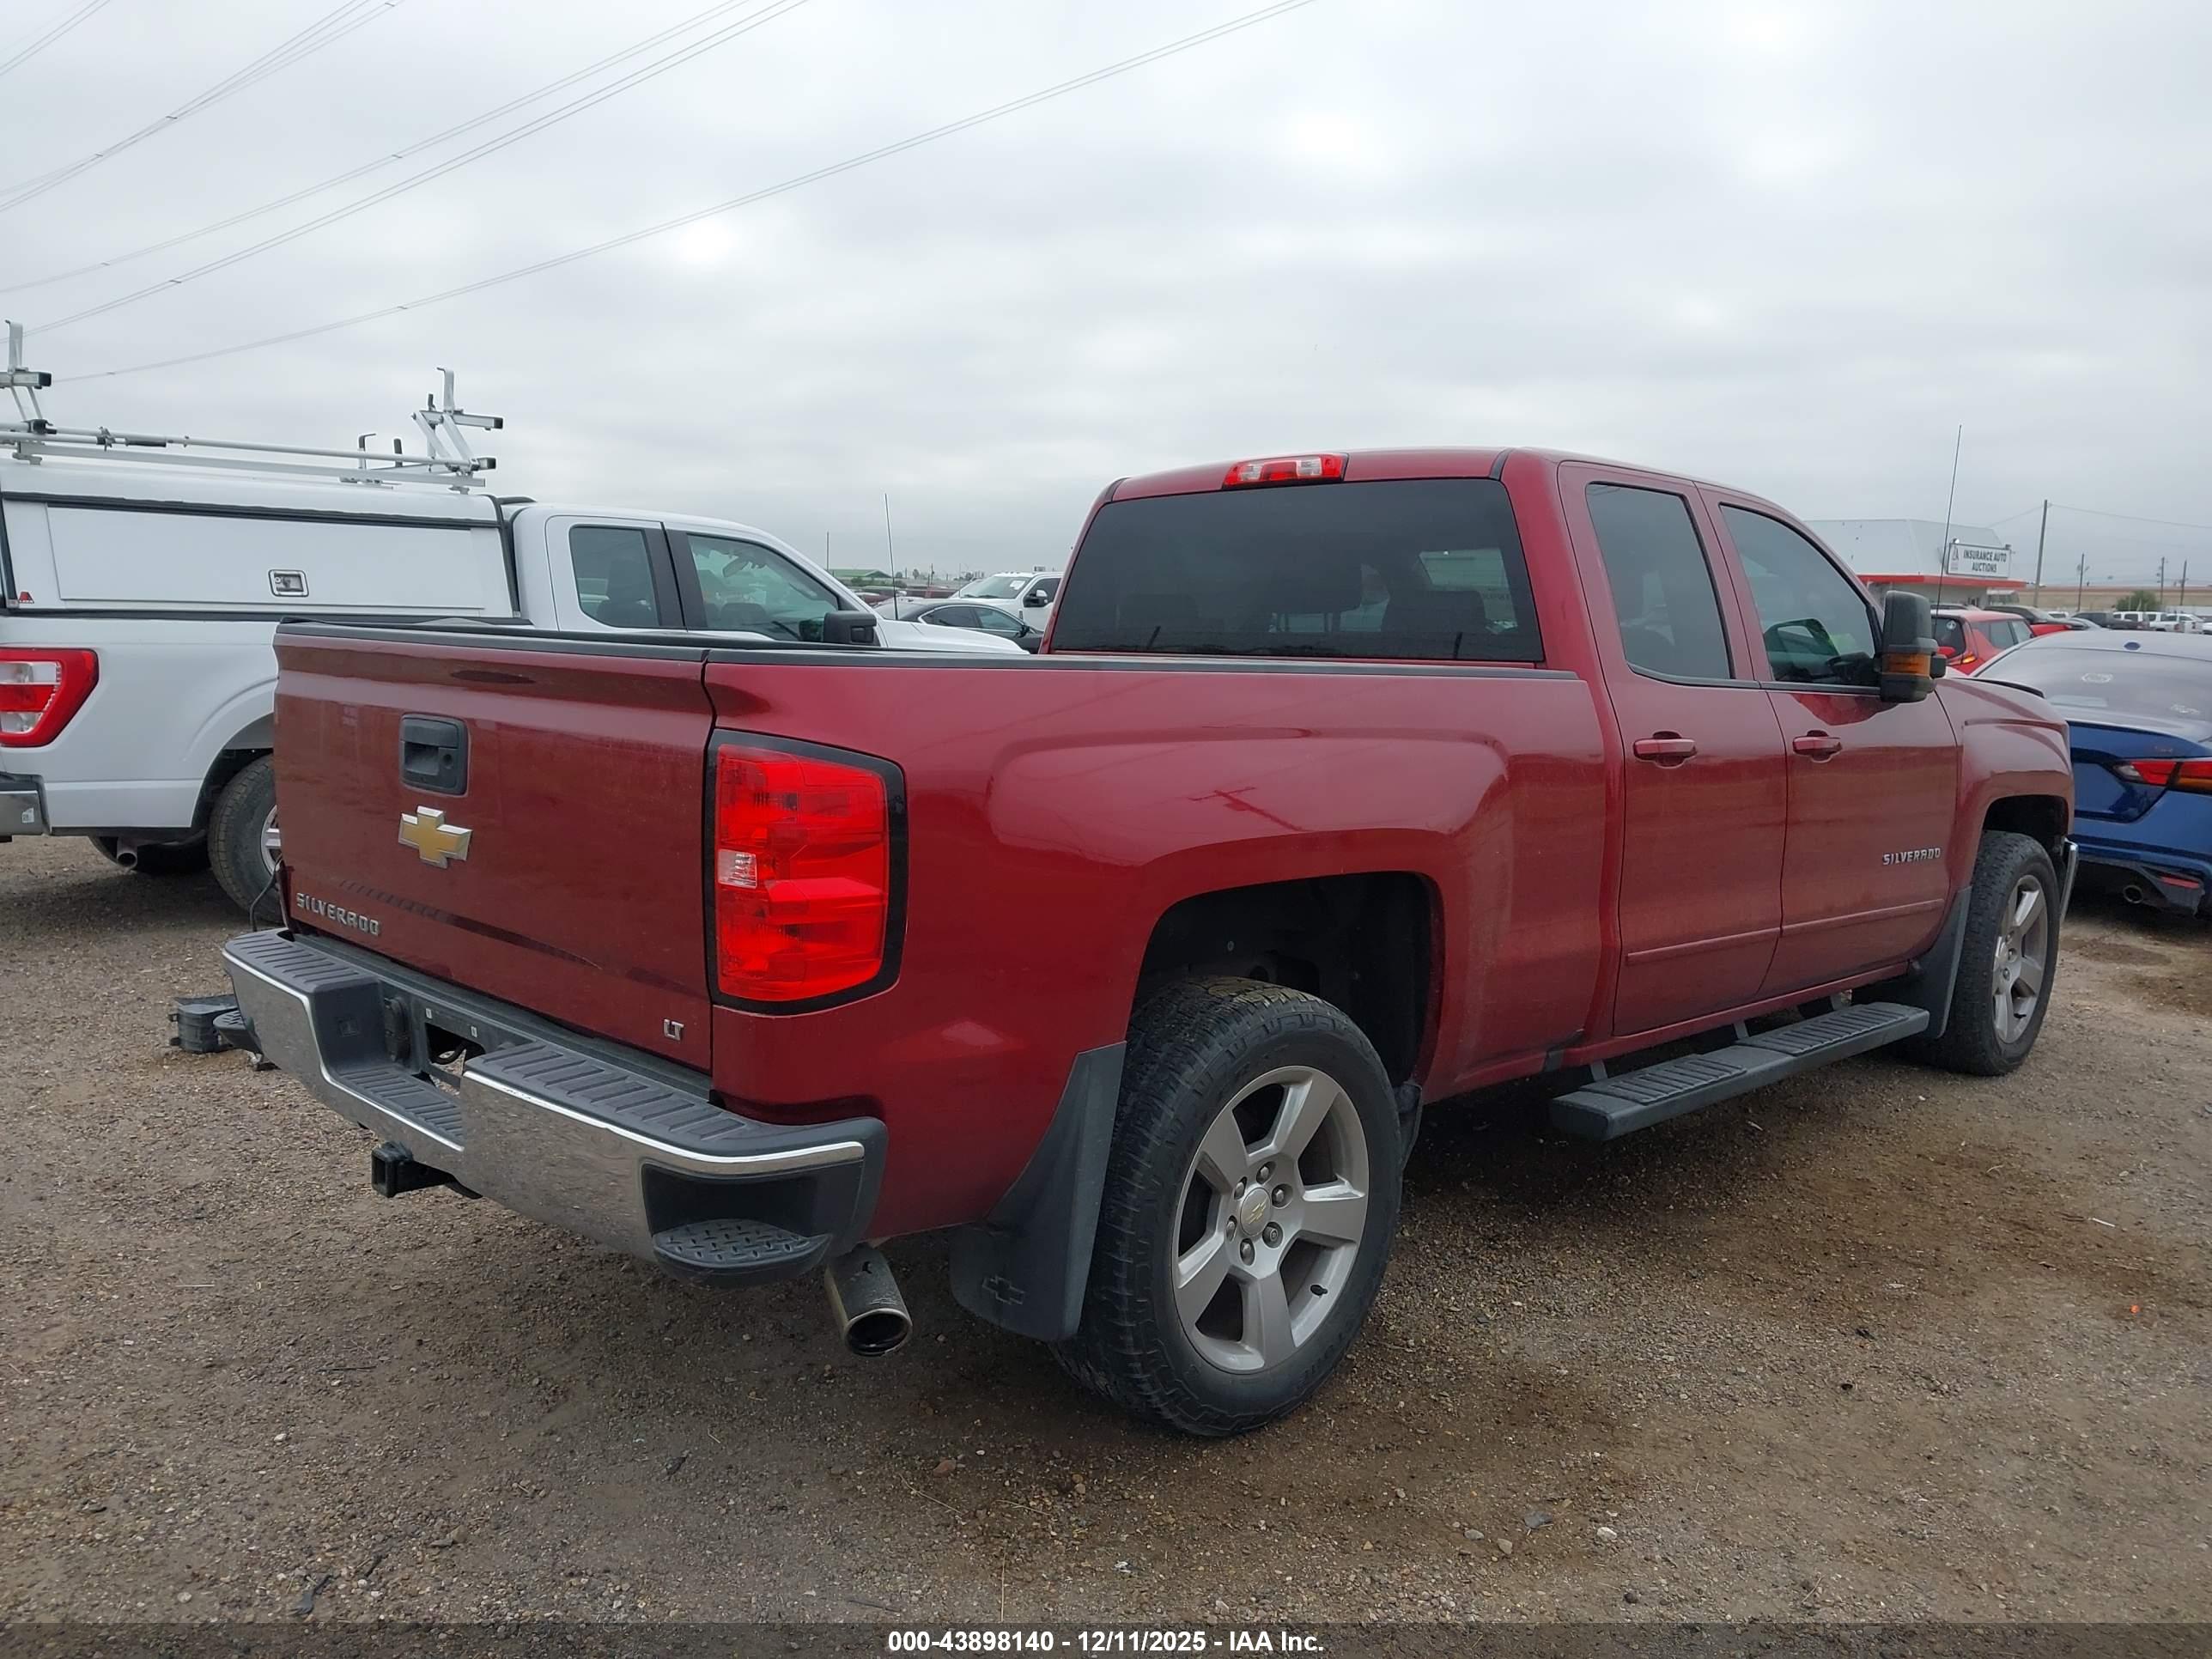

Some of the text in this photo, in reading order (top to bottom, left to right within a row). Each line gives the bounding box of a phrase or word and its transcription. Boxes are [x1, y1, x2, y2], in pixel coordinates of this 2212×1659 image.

[1963, 549, 1992, 562] INSURANCE
[1993, 552, 2007, 562] AUTO
[1972, 562, 1997, 573] AUCTIONS
[1882, 847, 1942, 866] SILVERADO
[295, 892, 380, 936] SILVERADO
[663, 1018, 685, 1041] LT
